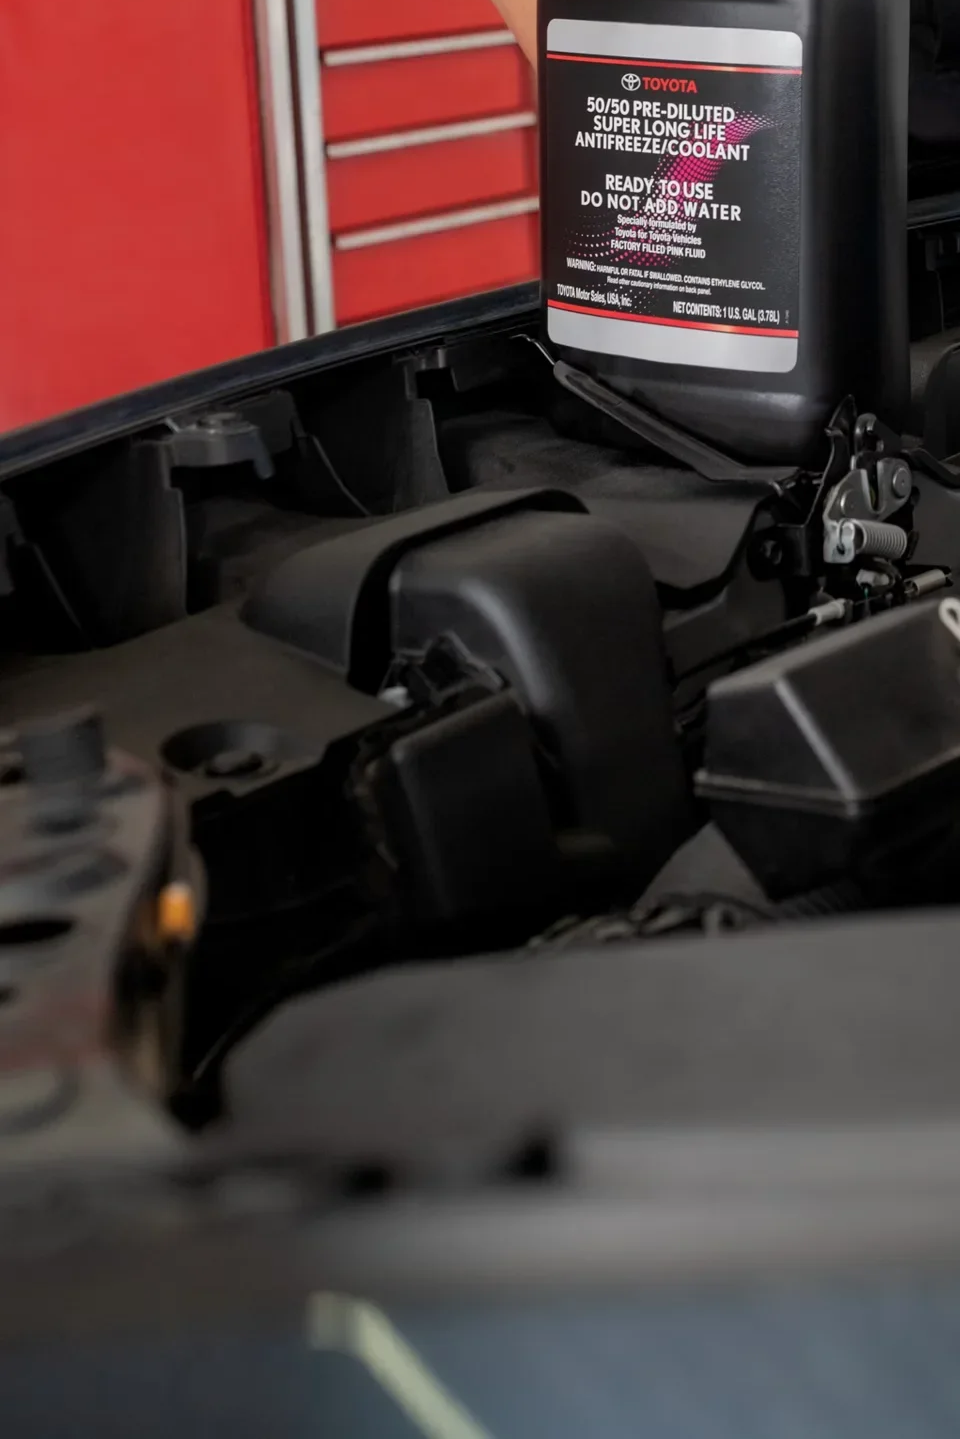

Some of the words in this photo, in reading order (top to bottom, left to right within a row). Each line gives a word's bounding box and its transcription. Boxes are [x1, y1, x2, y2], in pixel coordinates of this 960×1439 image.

[642, 77, 698, 93] TOYOTA
[587, 96, 630, 115] 50/50
[633, 100, 735, 122] PRE-DILUTED
[593, 115, 640, 134] SUPER
[644, 119, 690, 138] LONG
[694, 124, 726, 141] LIFE
[575, 132, 750, 161] ANTIFREEZE/COOLANT
[605, 174, 652, 194] READY
[660, 179, 682, 196] TO
[683, 182, 714, 200] USE
[581, 191, 602, 207] DO
[607, 193, 640, 211] NOT
[644, 197, 678, 215] ADD
[683, 201, 741, 221] WATER
[617, 214, 648, 228] Specially
[648, 218, 686, 230] formulated
[688, 222, 696, 233] by
[614, 227, 637, 238] Toyota
[638, 229, 648, 239] for
[648, 231, 672, 242] Toyota
[672, 233, 702, 245] Vehicles
[610, 239, 641, 252] FACTORY
[642, 243, 666, 254] FILLED
[666, 246, 684, 257] PINK
[685, 247, 706, 259] FLUID
[566, 257, 596, 272] WARNING:
[596, 264, 620, 275] HARMFUL
[620, 267, 628, 276] OR
[628, 268, 643, 278] FATAL
[644, 270, 648, 279] IF
[650, 270, 684, 282] SWALLOWED.
[684, 275, 710, 286] CONTAINS
[712, 278, 740, 288] ETHYLENE
[740, 280, 766, 290] GLYCOL.
[606, 276, 619, 284] Read
[619, 277, 630, 286] other
[630, 278, 653, 290] cautionary
[654, 281, 678, 291] information
[685, 286, 696, 294] back
[557, 283, 576, 297] TOYOTA
[576, 287, 590, 300] Motor
[590, 290, 606, 305] Sales,
[673, 301, 686, 314] NET
[686, 302, 722, 318] CONTENTS:
[722, 306, 726, 318] 1
[727, 306, 741, 320] U.S.
[742, 308, 757, 321] GAL
[757, 309, 780, 325] (3.78L)
